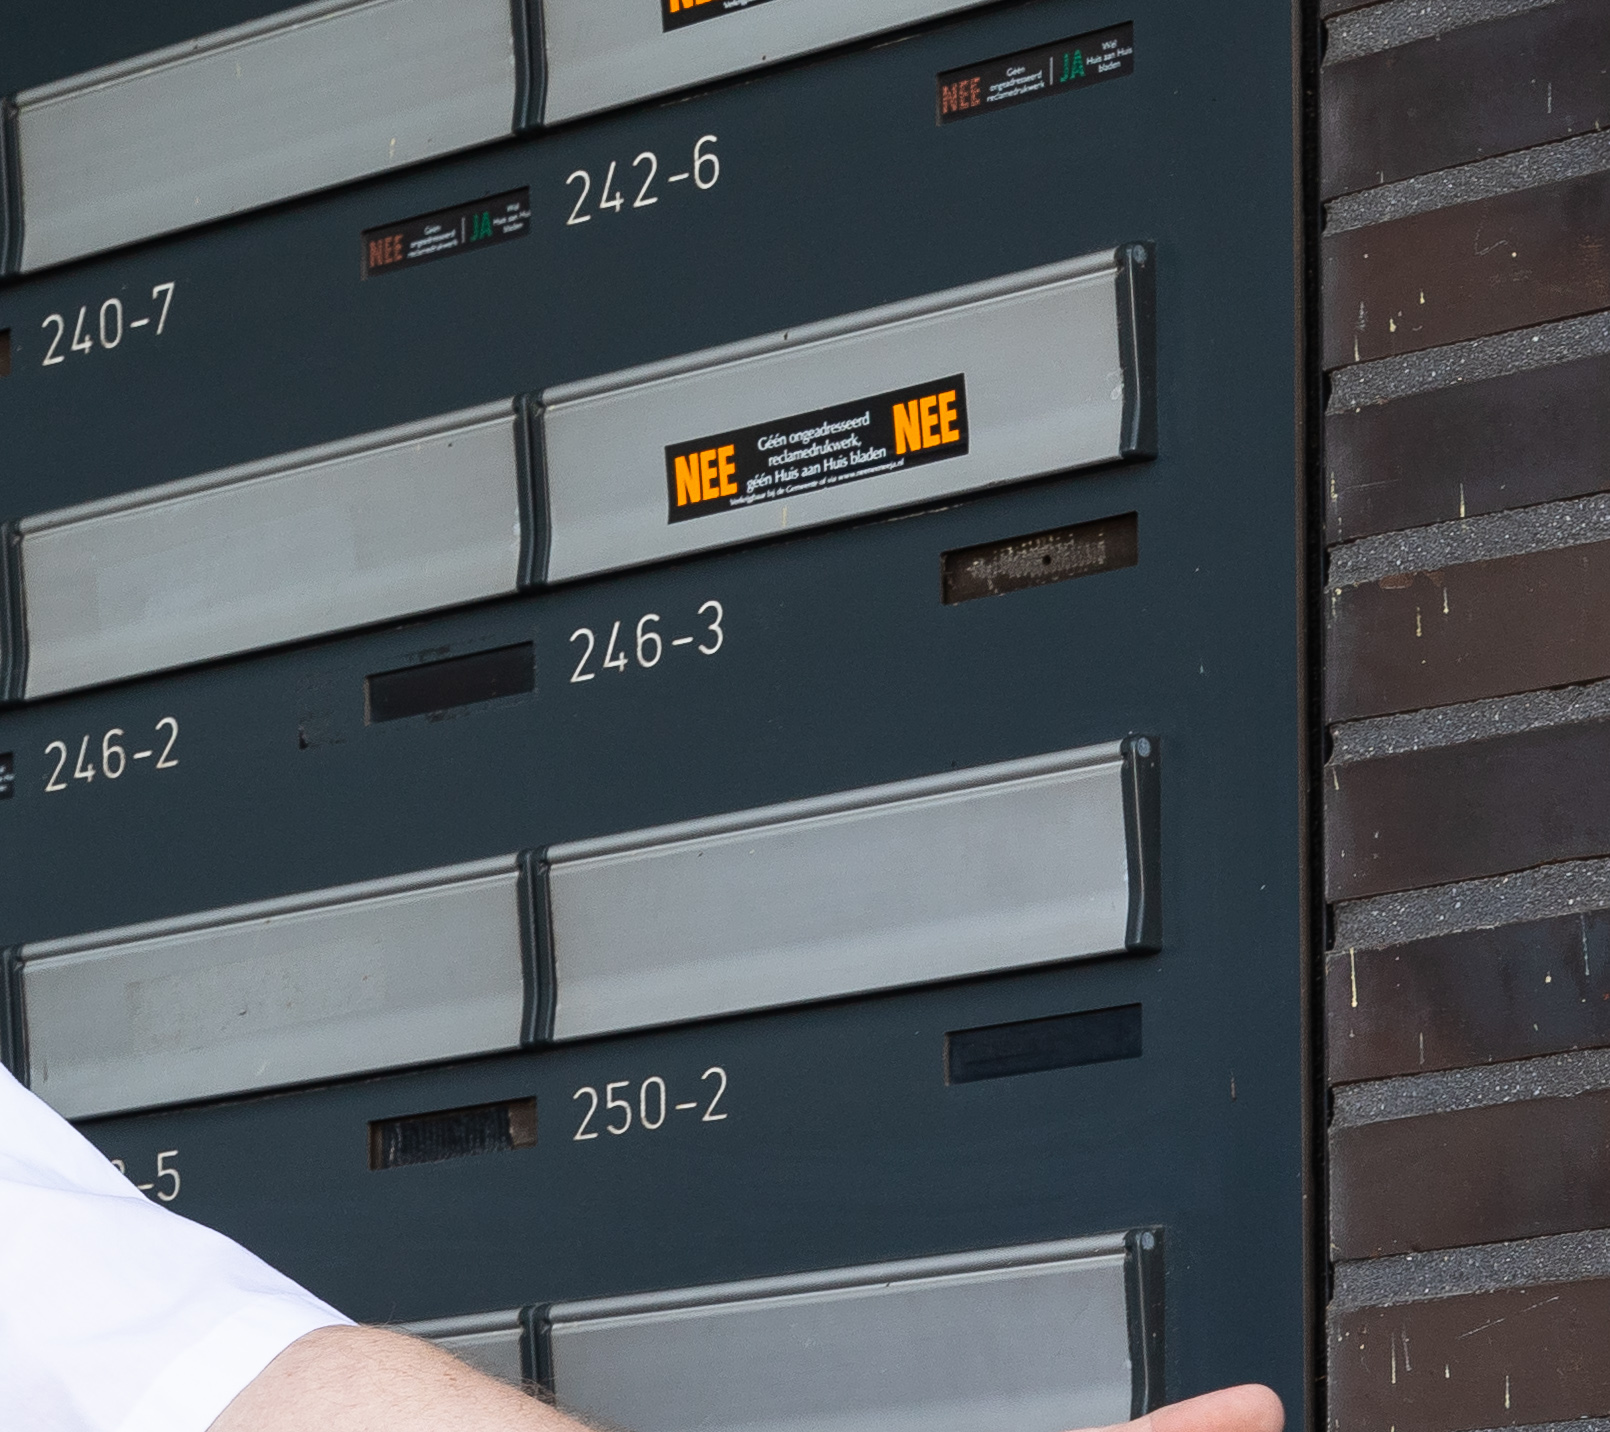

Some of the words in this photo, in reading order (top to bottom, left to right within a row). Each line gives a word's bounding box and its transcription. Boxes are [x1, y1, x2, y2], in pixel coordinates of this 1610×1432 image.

[942, 77, 981, 115] NEE
[1060, 50, 1086, 83] JA
[565, 134, 720, 226] 242-6
[369, 234, 404, 268] NEE
[470, 211, 493, 242] JA
[41, 281, 175, 366] 240-7
[789, 411, 870, 446] ongeadresseerd
[892, 389, 960, 455] NEE
[674, 444, 738, 507] NEE
[774, 468, 799, 484] Huis
[801, 465, 821, 479] aan
[823, 455, 848, 473] Huis
[850, 446, 887, 466] bladen
[569, 600, 724, 683] 246-3
[44, 716, 179, 792] 246-2
[572, 1066, 728, 1141] 250-2
